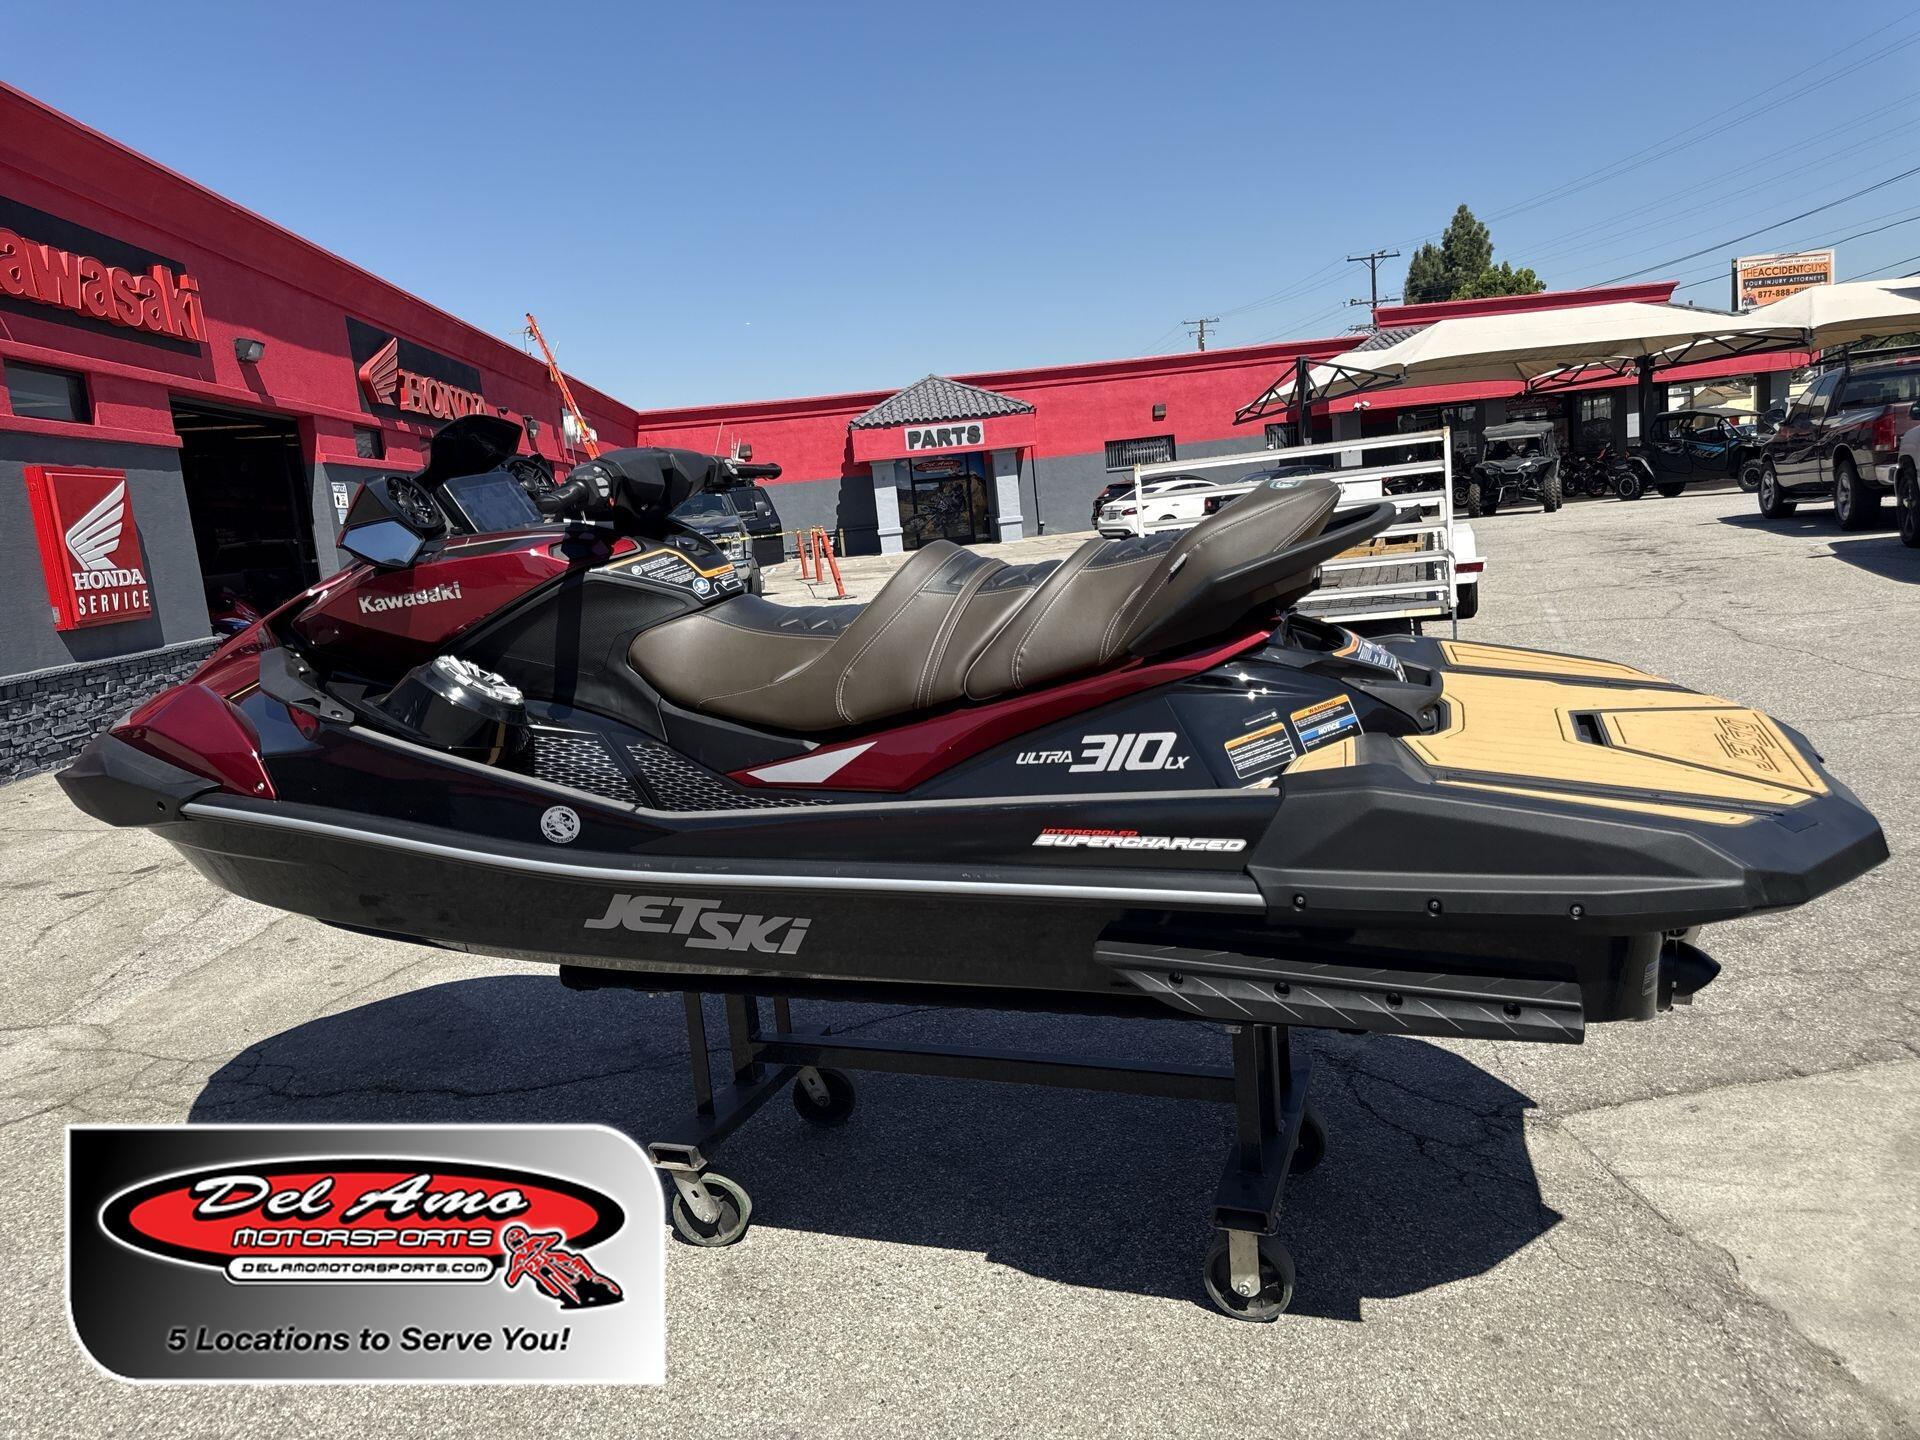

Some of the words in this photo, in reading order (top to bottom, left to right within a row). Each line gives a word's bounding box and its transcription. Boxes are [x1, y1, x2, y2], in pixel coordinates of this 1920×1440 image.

[1789, 274, 1825, 283] ATTORNEYS
[400, 368, 488, 421] HONDA
[907, 425, 981, 450] PARTS
[72, 569, 147, 591] HONDA
[78, 590, 150, 616] SERVICE
[358, 581, 462, 614] Kawasaki
[1016, 751, 1073, 765] ULTRA
[1069, 732, 1177, 773] 310
[1164, 756, 1190, 770] LX
[1032, 834, 1247, 852] SUPERCHARGED
[1042, 828, 1139, 838] INTERCOOLED
